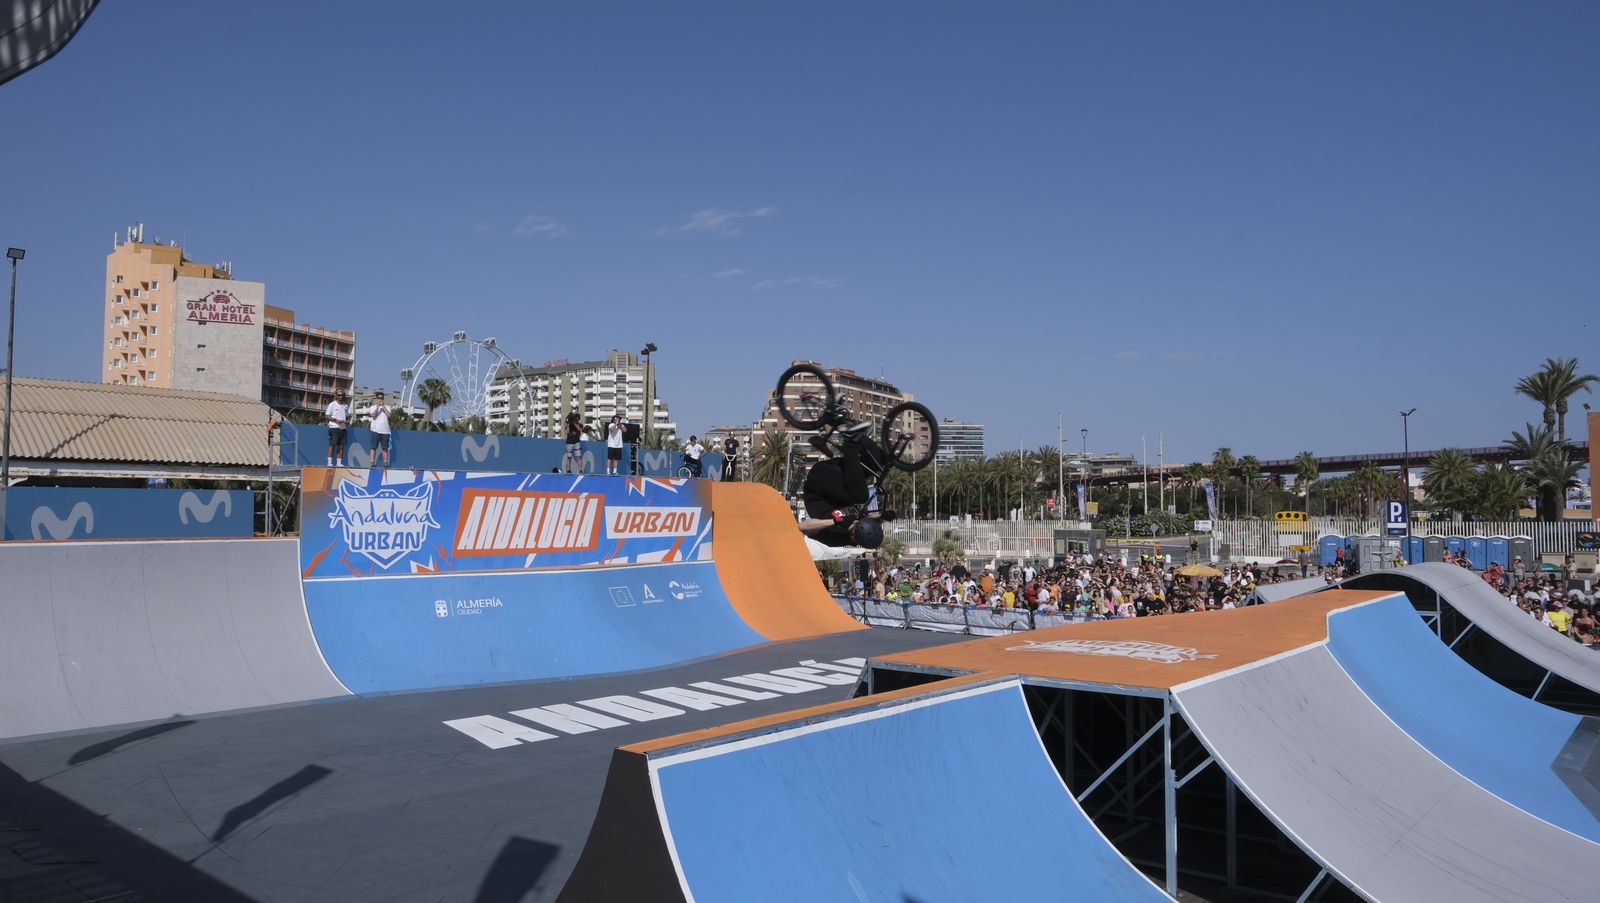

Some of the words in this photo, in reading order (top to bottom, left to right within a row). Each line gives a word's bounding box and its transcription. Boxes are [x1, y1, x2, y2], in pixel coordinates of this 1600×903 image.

[186, 302, 216, 312] GRAN
[222, 305, 256, 315] HOTEL
[188, 310, 252, 323] ALMERIA
[329, 499, 440, 529] Andalucía
[456, 492, 599, 550] ANDALUCÍA
[613, 511, 696, 534] URBAN
[350, 531, 421, 551] URBAN
[456, 596, 503, 609] ALMERÍA
